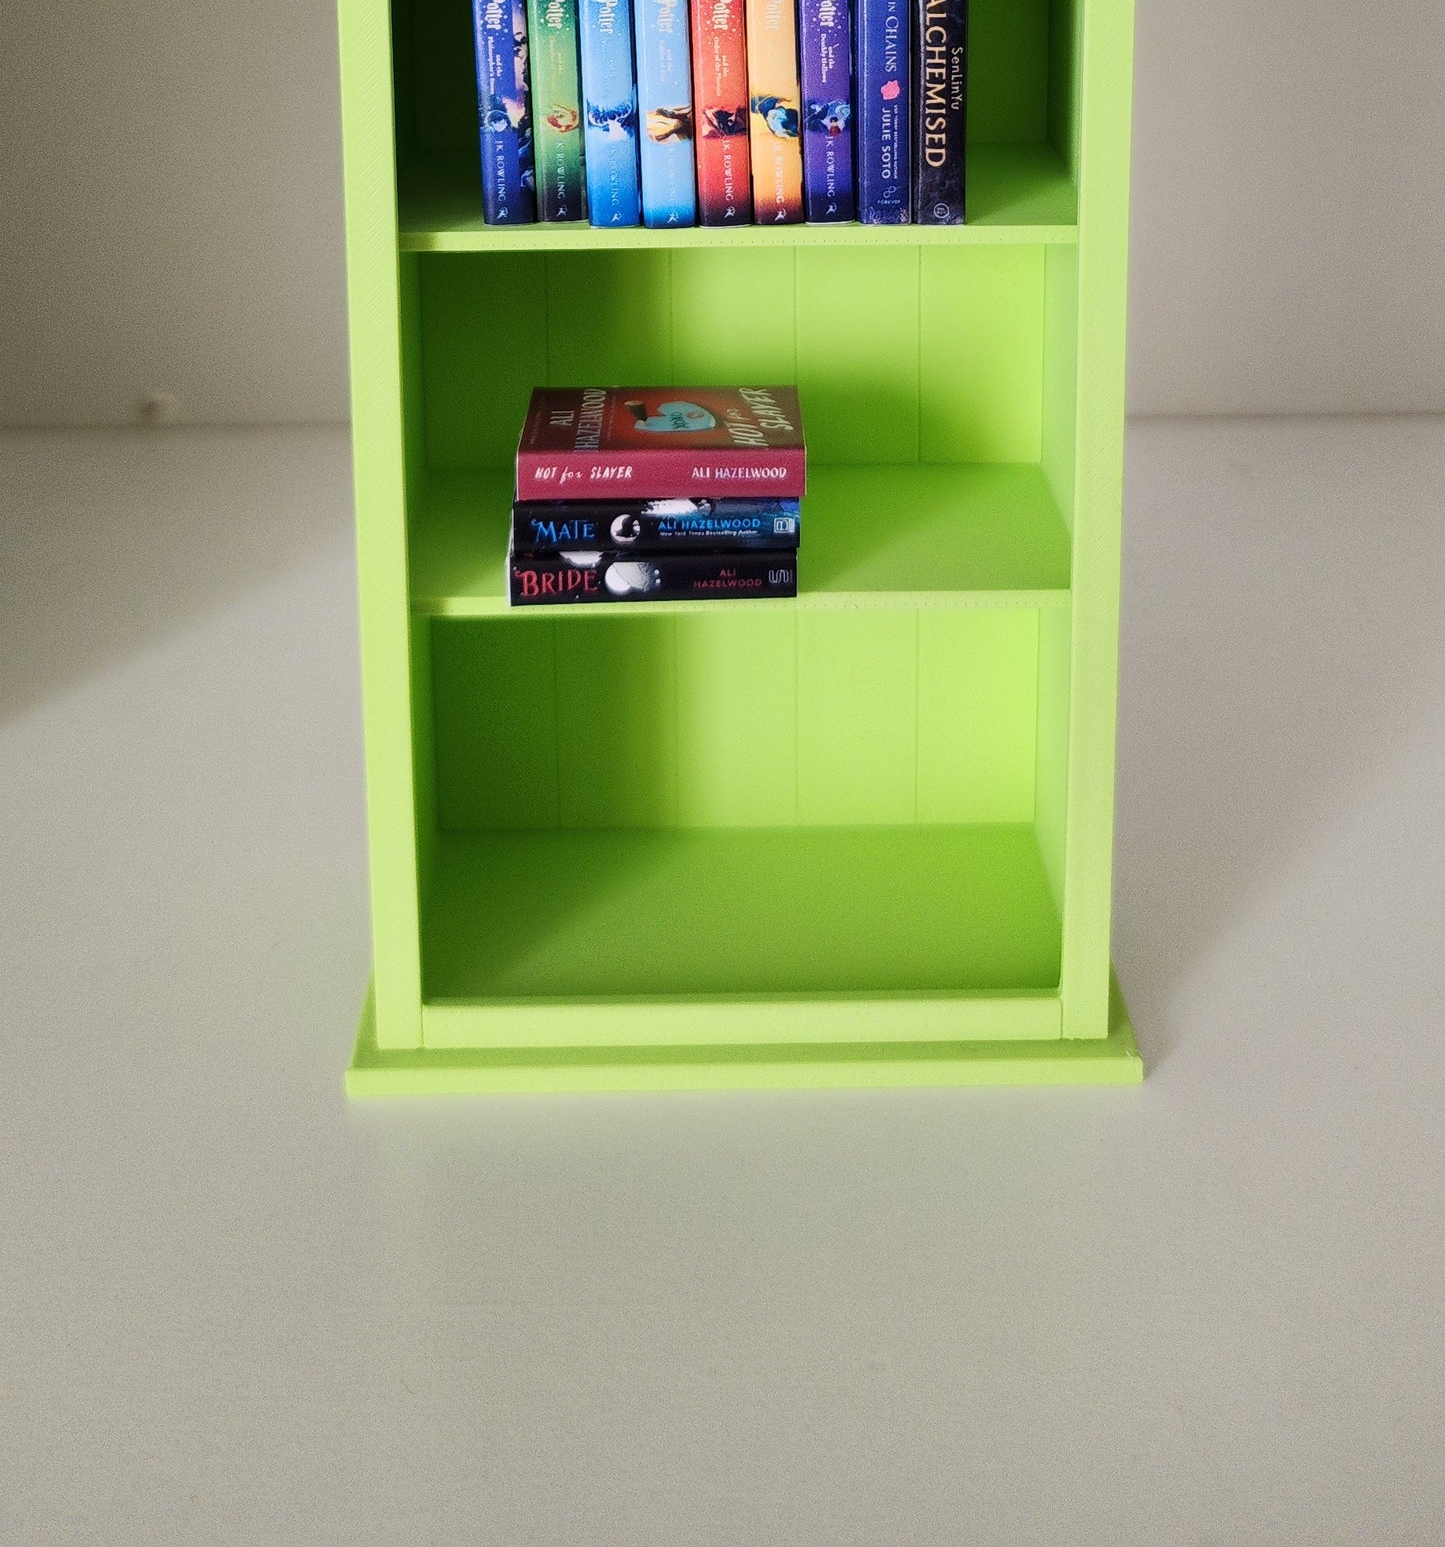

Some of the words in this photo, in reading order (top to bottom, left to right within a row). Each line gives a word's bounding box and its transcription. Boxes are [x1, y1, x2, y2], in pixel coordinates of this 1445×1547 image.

[887, 1, 896, 12] IN
[884, 15, 899, 72] CHAINS
[950, 47, 963, 110] SenLinYu
[881, 107, 892, 141] JULIE
[496, 155, 507, 202] ROWLING
[556, 152, 566, 200] ROWLING
[723, 154, 734, 201] ROWLING
[825, 151, 836, 198] ROWLING
[881, 145, 892, 179] SOTO
[774, 155, 785, 204] ROWLING
[549, 410, 575, 427] ALI
[573, 388, 607, 453] HAZELWOOD
[738, 387, 794, 431] SLAYER
[724, 421, 769, 447] HOT
[534, 467, 555, 479] HOT
[559, 466, 583, 484] for
[590, 465, 633, 479] SLAYER
[691, 467, 710, 479] ALI
[714, 467, 787, 479] HAZELWOOD
[531, 518, 596, 544] MATE
[658, 520, 677, 531] ALI
[681, 518, 761, 530] HAZELWOOD
[514, 569, 600, 598] BRIDE
[693, 578, 763, 589] HAZELWOOD
[719, 568, 737, 577] ALI
